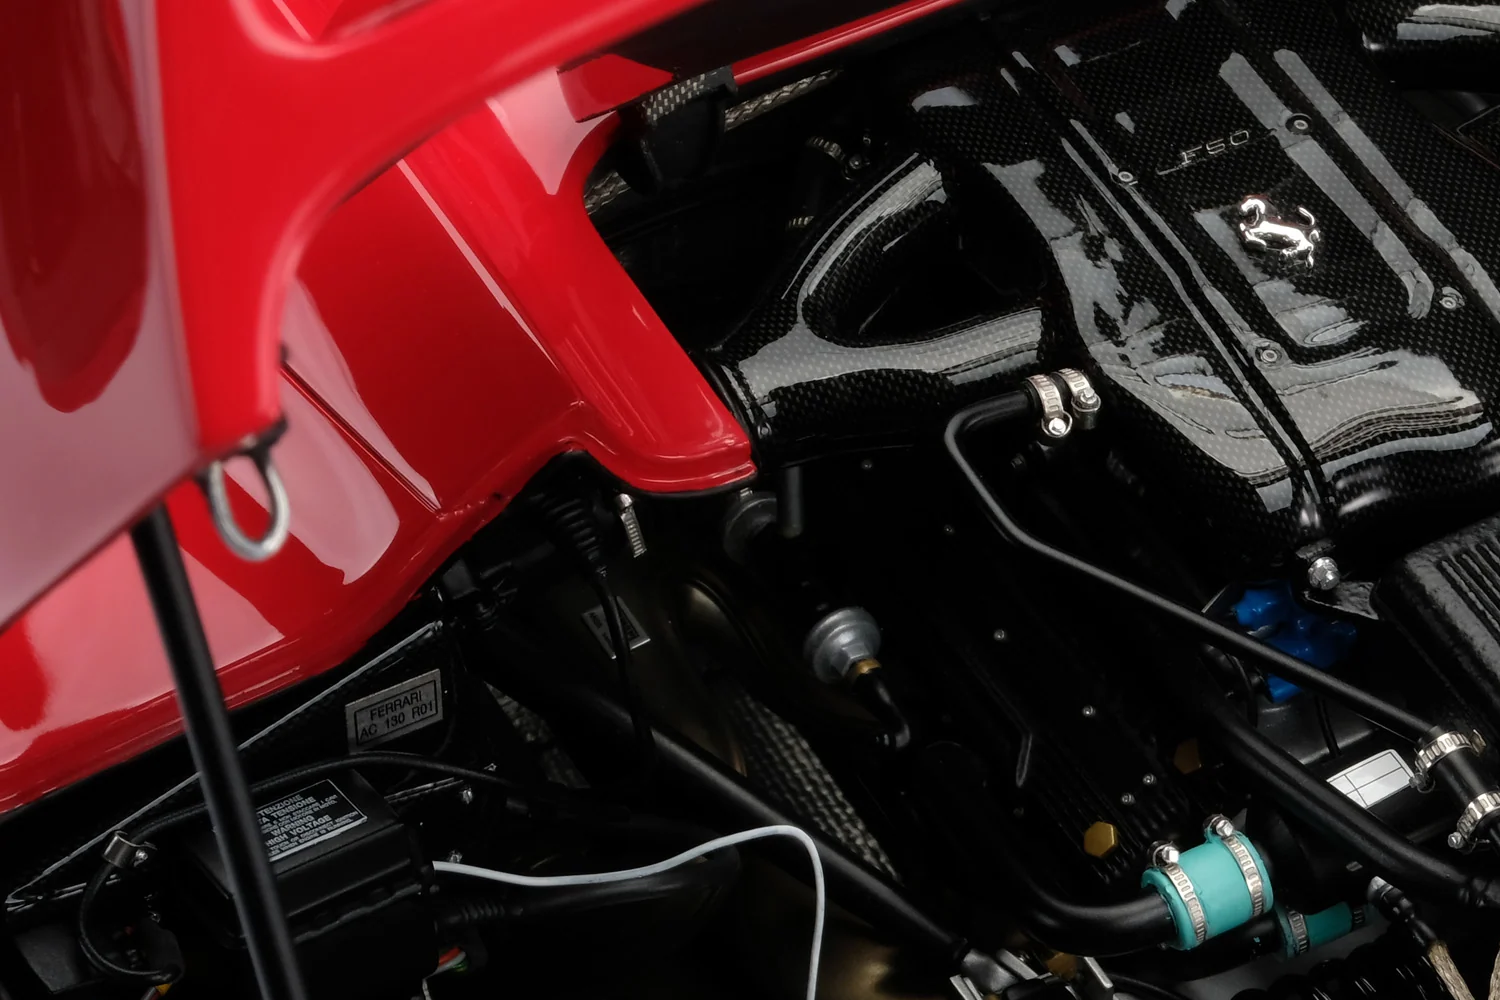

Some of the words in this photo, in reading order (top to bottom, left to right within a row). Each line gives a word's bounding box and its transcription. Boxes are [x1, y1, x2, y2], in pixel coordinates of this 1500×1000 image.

[360, 723, 378, 741] AC
[411, 701, 434, 719] R01
[370, 690, 423, 721] FERRARI
[270, 796, 317, 819] TENSIONE
[264, 832, 289, 847] HIGH
[290, 814, 332, 837] VOLTAGE
[271, 815, 316, 837] WARNING
